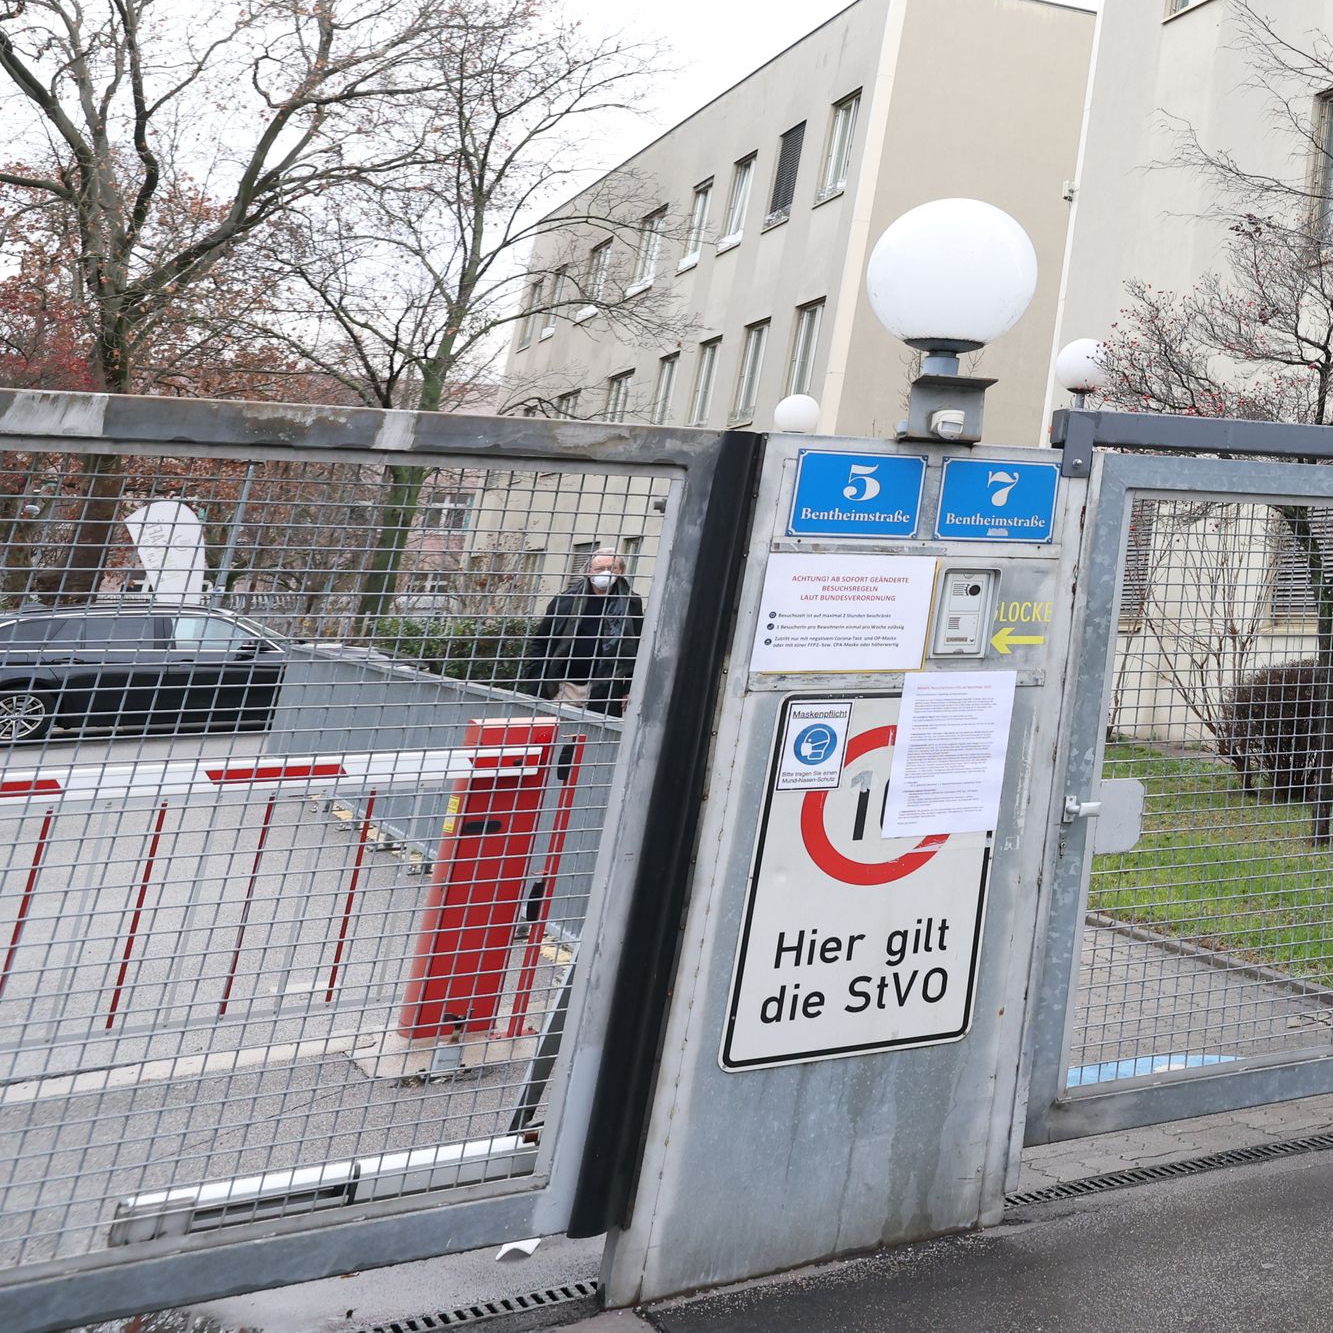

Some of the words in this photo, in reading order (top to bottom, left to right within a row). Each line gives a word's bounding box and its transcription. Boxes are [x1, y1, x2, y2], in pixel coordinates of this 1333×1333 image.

[842, 464, 880, 501] 5
[987, 471, 1019, 506] 7
[801, 507, 910, 523] Bentheimstraße
[946, 513, 1045, 528] Bentheimstraße
[792, 575, 829, 583] ACHTUNG!
[870, 575, 909, 583] GEÄNDERTE
[994, 601, 1053, 622] LOCKE
[792, 710, 848, 719] Maskenpflicht
[773, 929, 866, 969] Hier
[885, 918, 949, 967] gilt
[760, 983, 825, 1024] die
[844, 967, 948, 1013] StVO
